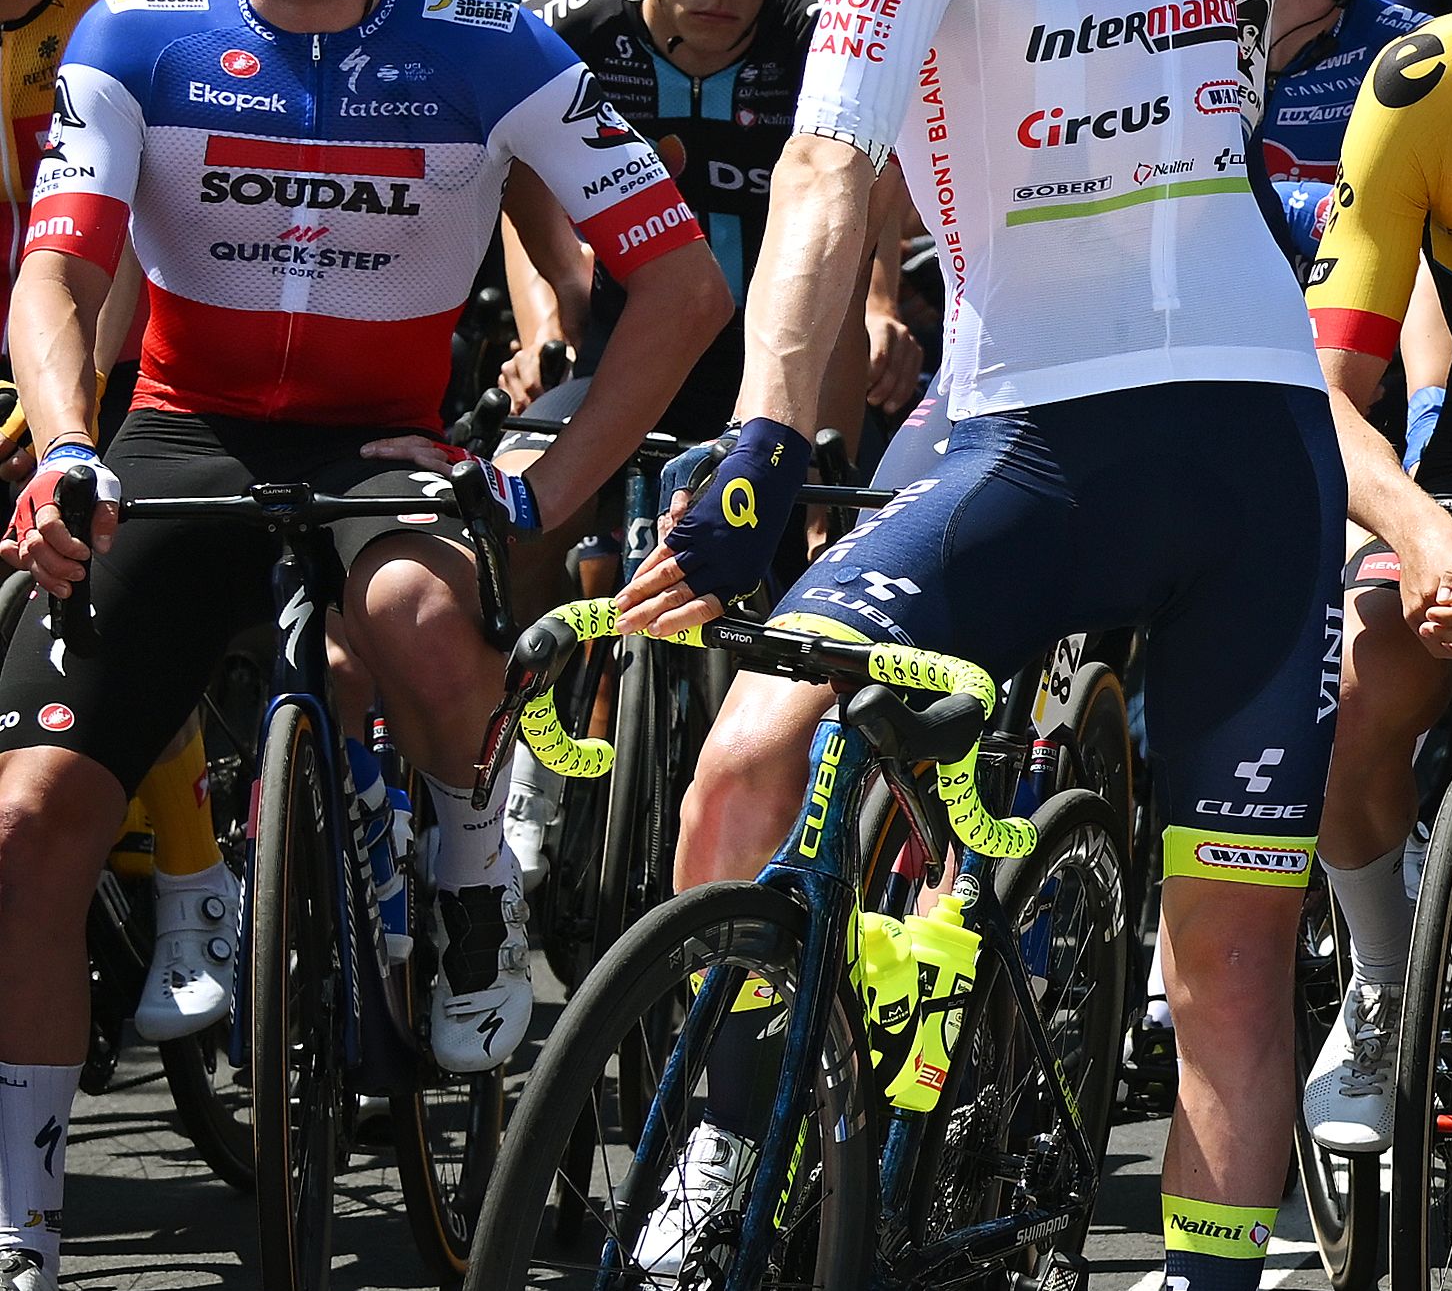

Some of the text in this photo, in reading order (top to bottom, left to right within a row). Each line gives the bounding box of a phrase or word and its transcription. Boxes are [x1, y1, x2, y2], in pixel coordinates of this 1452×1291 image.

[454, 6, 514, 24] JOGGER
[188, 81, 288, 114] Ekopak
[340, 97, 440, 119] latexco
[918, 47, 955, 226] BLANC MONT
[1016, 94, 1171, 150] Circus
[1153, 158, 1195, 177] Nalini
[200, 171, 421, 216] SOUDAL
[1014, 179, 1112, 201] GOBERT
[271, 266, 326, 280] FLOORS
[1315, 601, 1346, 725] VINI
[798, 733, 848, 859] CUBE
[1195, 798, 1309, 821] CUBE
[1207, 844, 1305, 871] WANTY
[1015, 1213, 1071, 1246] SHIMANO
[1169, 1211, 1245, 1243] Nalini
